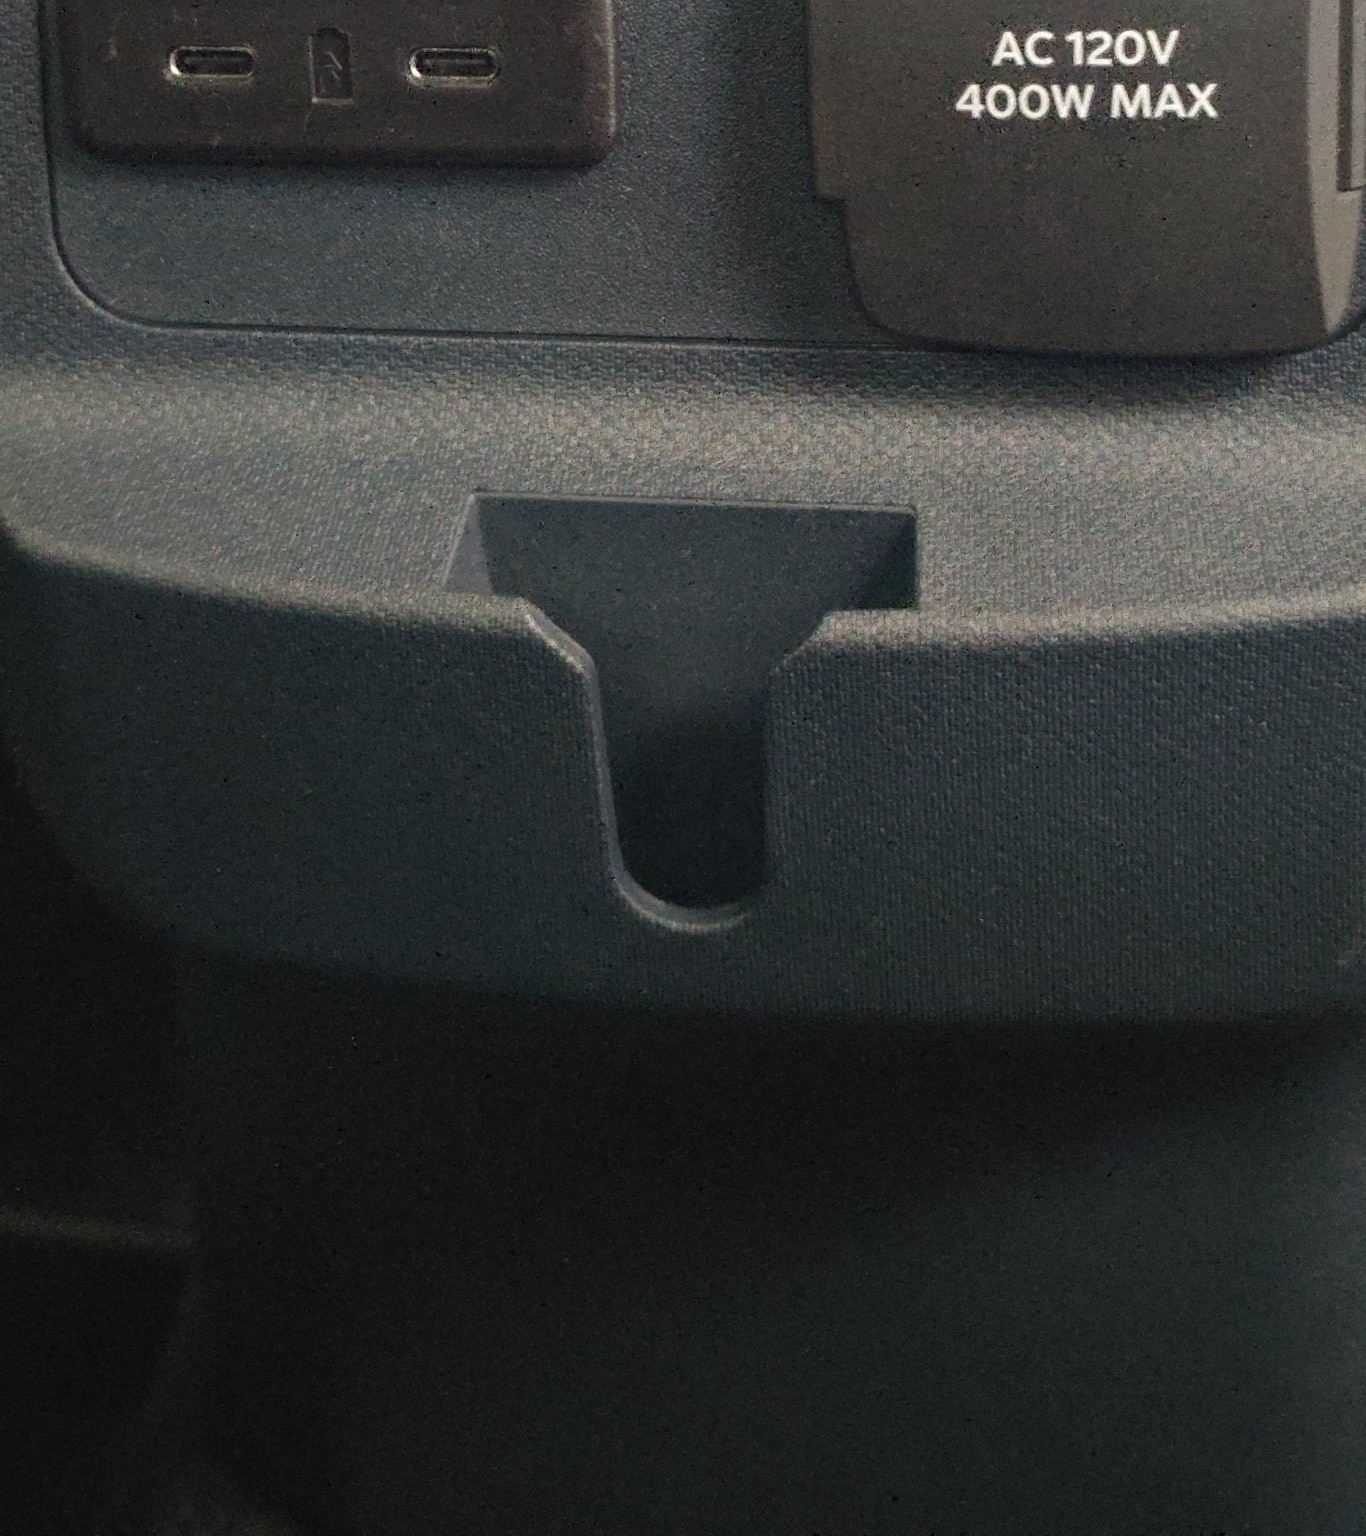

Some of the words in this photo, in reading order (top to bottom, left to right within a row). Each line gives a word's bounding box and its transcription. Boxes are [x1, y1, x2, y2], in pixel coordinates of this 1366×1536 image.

[991, 30, 1055, 67] AC
[1064, 29, 1180, 67] 120V
[955, 83, 1096, 120] 400W
[1110, 82, 1219, 119] MAX
